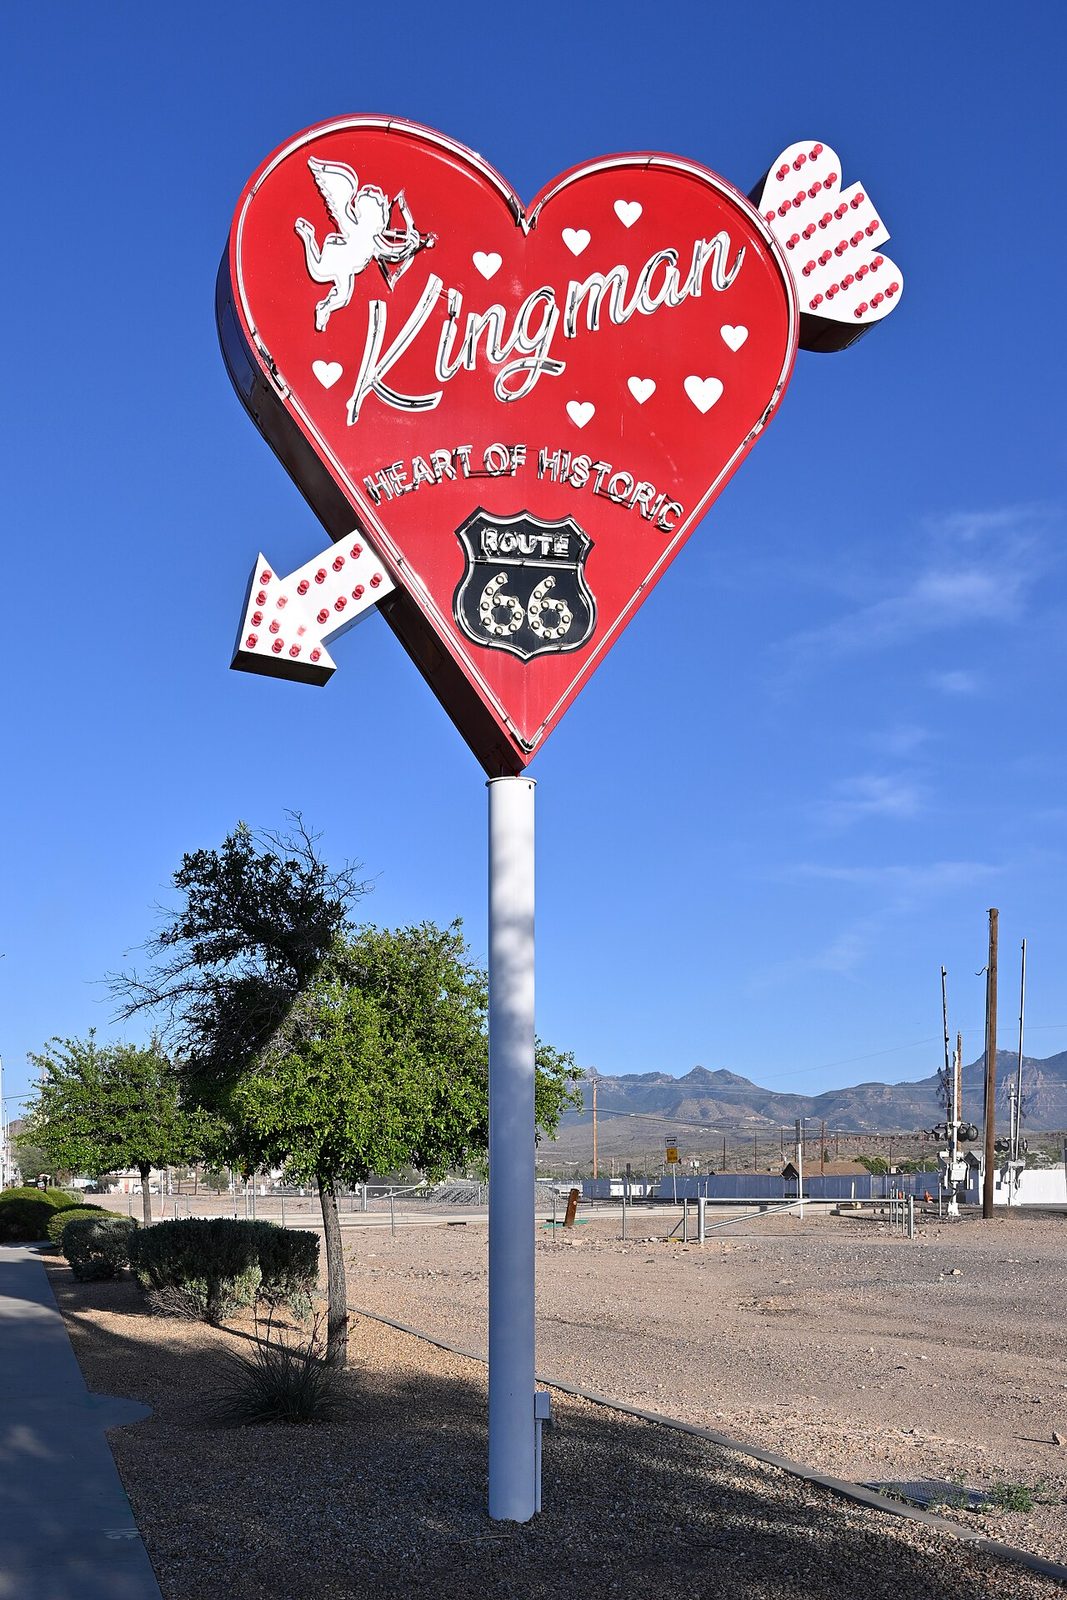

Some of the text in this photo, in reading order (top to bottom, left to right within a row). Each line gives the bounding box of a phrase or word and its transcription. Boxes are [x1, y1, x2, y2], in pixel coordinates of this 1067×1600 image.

[347, 230, 746, 426] Kingman
[363, 443, 684, 532] HEART OF HISTORIC
[481, 528, 570, 557] ROUTE
[479, 572, 572, 639] 66
